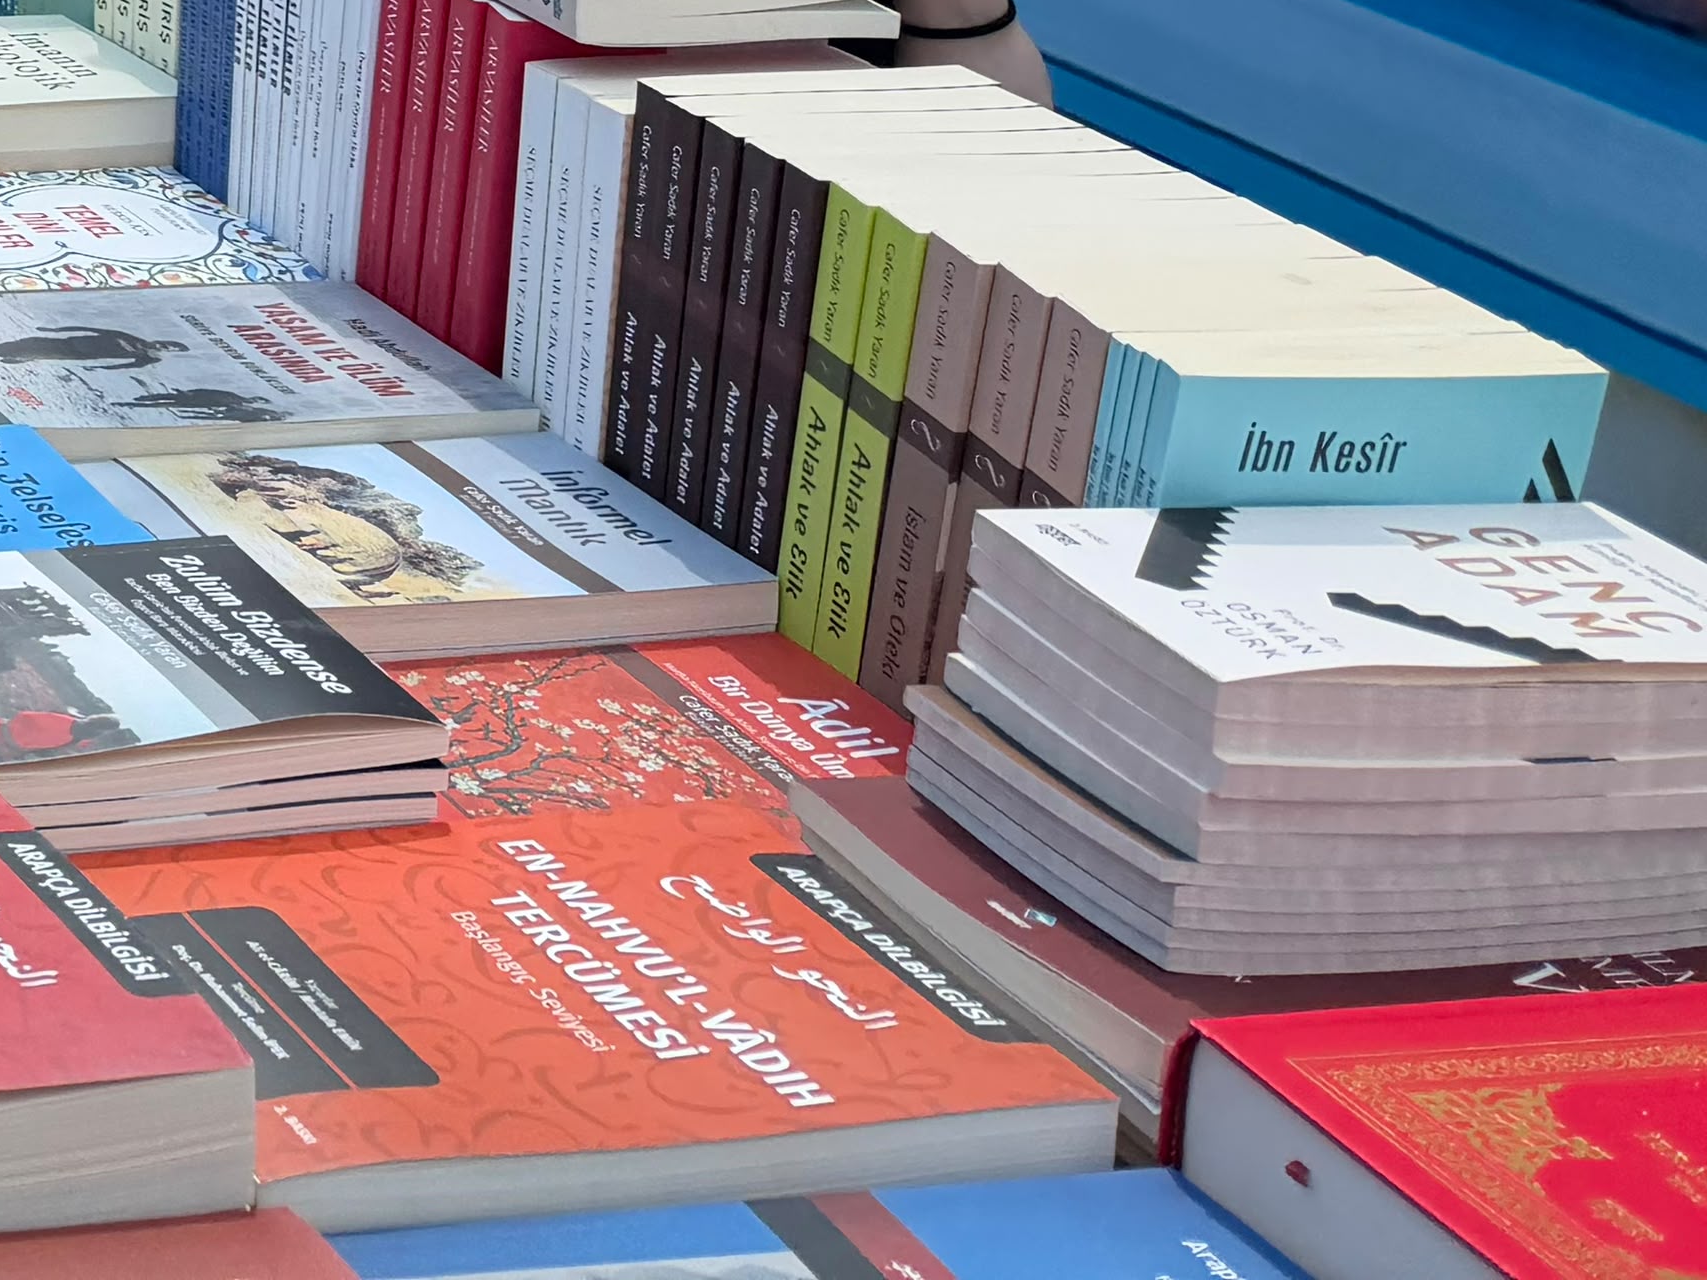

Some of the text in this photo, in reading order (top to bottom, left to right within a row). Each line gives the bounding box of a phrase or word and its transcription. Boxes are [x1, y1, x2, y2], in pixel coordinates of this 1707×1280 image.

[8, 31, 98, 79] İmanın
[12, 212, 76, 235] DİNİ
[54, 204, 124, 239] TEMEL
[226, 324, 335, 384] ARASINDA
[253, 302, 416, 398] YAŞAM VE ÖLÜM
[621, 362, 630, 391] ve
[649, 387, 659, 412] ve
[802, 406, 827, 497] Ahlak
[1238, 421, 1408, 474] İbn Kesîr
[895, 505, 916, 573] İslam
[1383, 526, 1645, 639] ADAM
[1468, 526, 1705, 635] GENÇ
[144, 572, 286, 676] Ben Bizden Değilim
[158, 554, 244, 607] Zulüm
[229, 609, 354, 695] Bizdense
[1179, 599, 1286, 659] ÖZTÜRK
[1226, 602, 1324, 656] OSMAN
[679, 695, 794, 783] Cafer Sadık Yara
[708, 674, 816, 752] Bir Dünya
[777, 697, 899, 758] Âdil
[7, 841, 170, 982] ARAPÇA DİLBİLGİSİ
[776, 864, 1007, 1028] ARAPÇA DİLBİLGİSİ
[450, 910, 616, 1053] Başlangıç Seviyesi
[491, 890, 711, 1061] TERCÜMESİ
[1181, 1237, 1246, 1280] Arap
